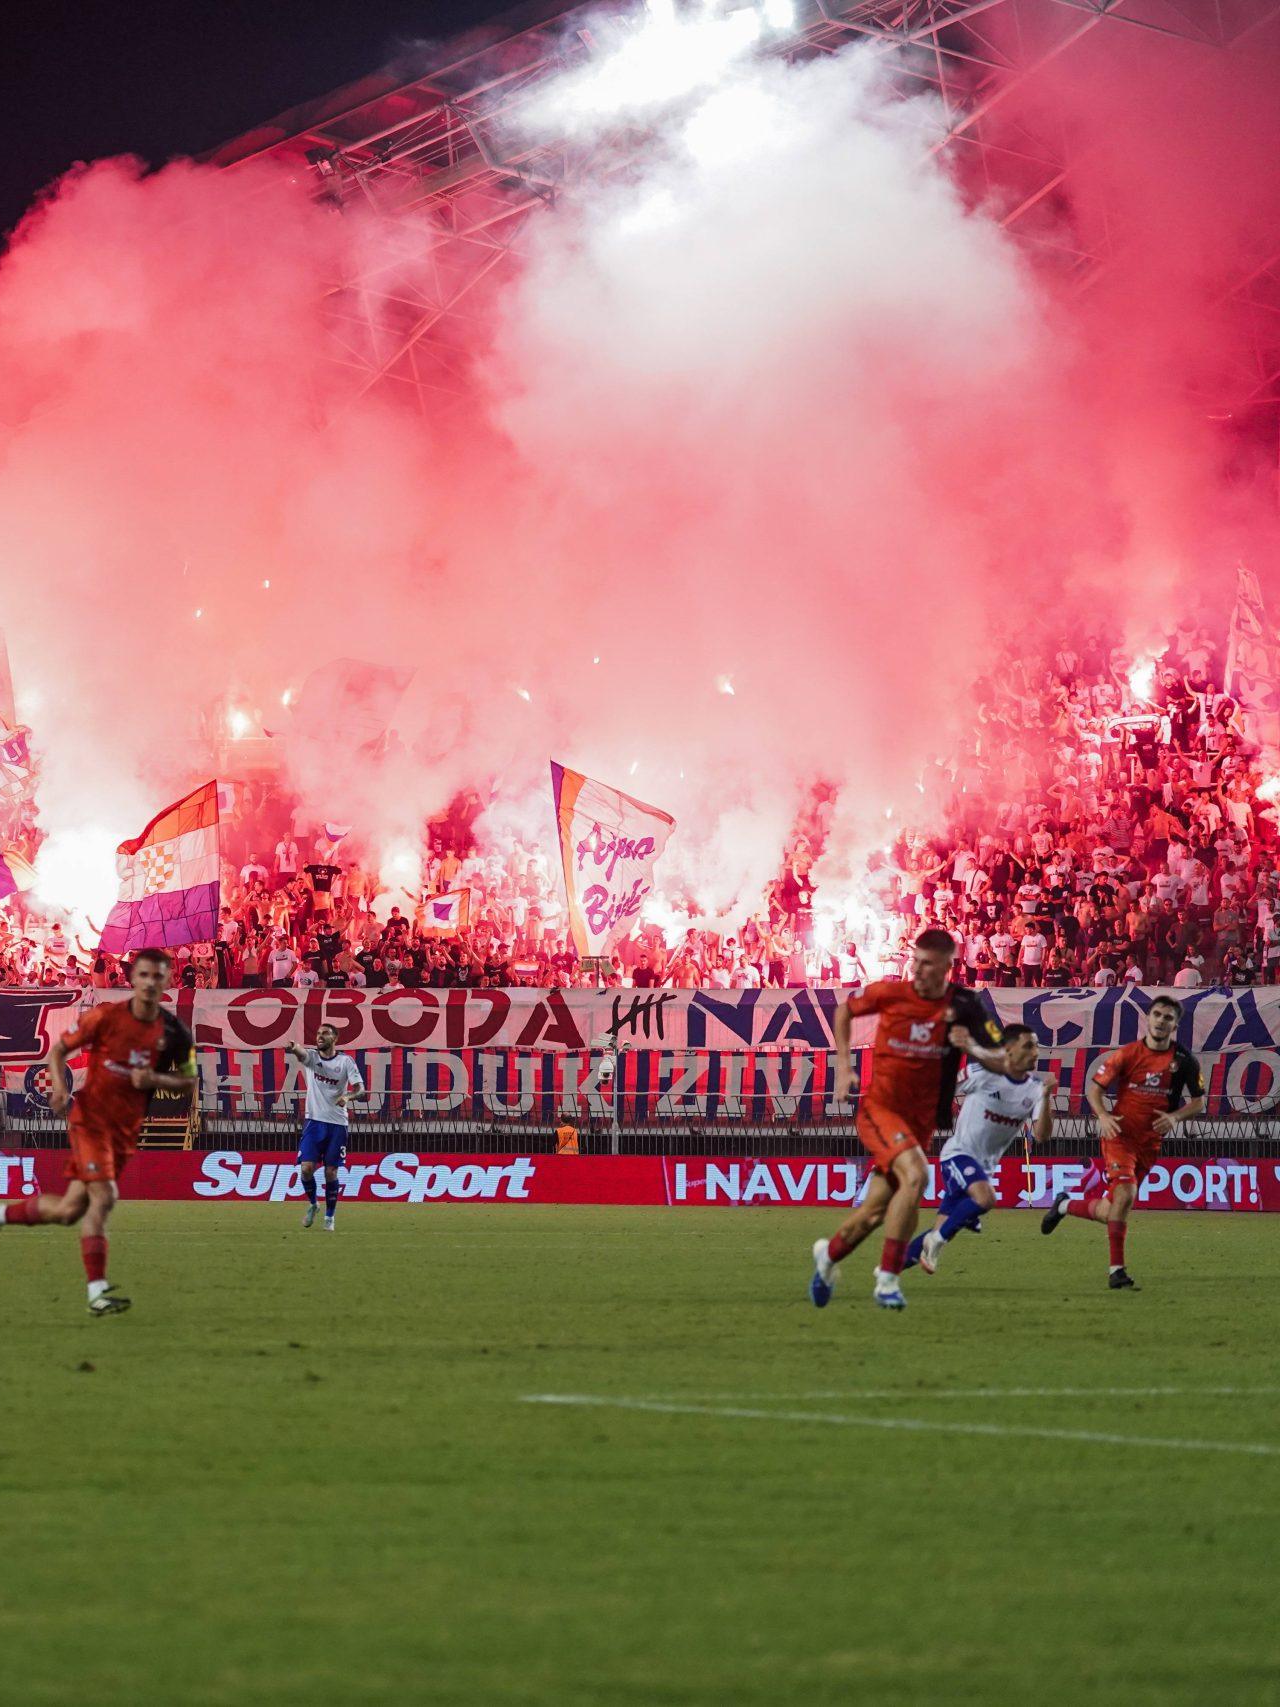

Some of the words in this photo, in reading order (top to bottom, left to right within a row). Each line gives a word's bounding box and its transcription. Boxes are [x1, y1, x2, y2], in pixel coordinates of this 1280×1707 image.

[160, 988, 586, 1049] LOBODA
[313, 1073, 339, 1086] TOMMY
[675, 1163, 687, 1200] I
[1019, 1164, 1084, 1201] JE
[1103, 1164, 1258, 1204] PORT!
